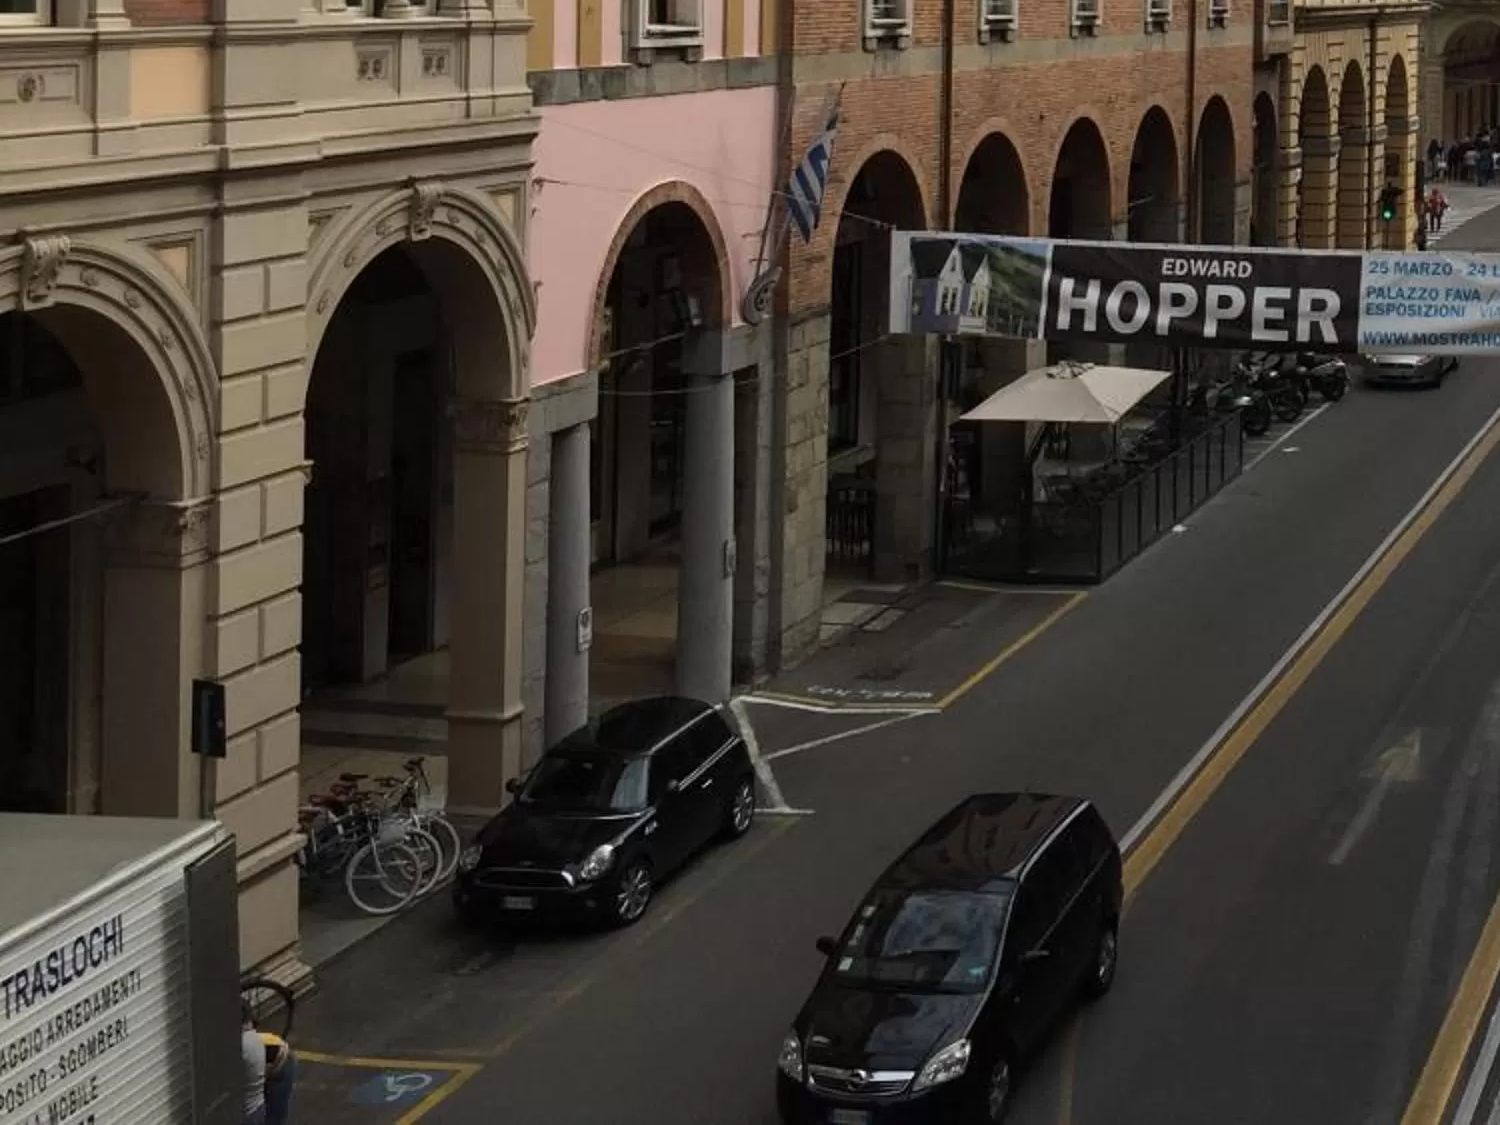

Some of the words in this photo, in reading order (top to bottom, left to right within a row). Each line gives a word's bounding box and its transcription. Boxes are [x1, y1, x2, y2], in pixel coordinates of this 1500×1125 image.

[1161, 257, 1252, 279] EDWARD
[1368, 260, 1389, 274] 25
[1393, 261, 1453, 276] MARZO
[1467, 263, 1487, 277] 24
[1056, 276, 1341, 345] HOPPER
[1366, 285, 1439, 301] PALAZZO
[1445, 286, 1482, 302] FAVA
[1366, 302, 1466, 317] ESPOSIZIONI
[1, 914, 124, 1020] TRASLOCHI
[47, 968, 142, 1045] ARREDAMENTI
[59, 1015, 129, 1080] SGOMBERI
[48, 1075, 98, 1125] MOBILE
